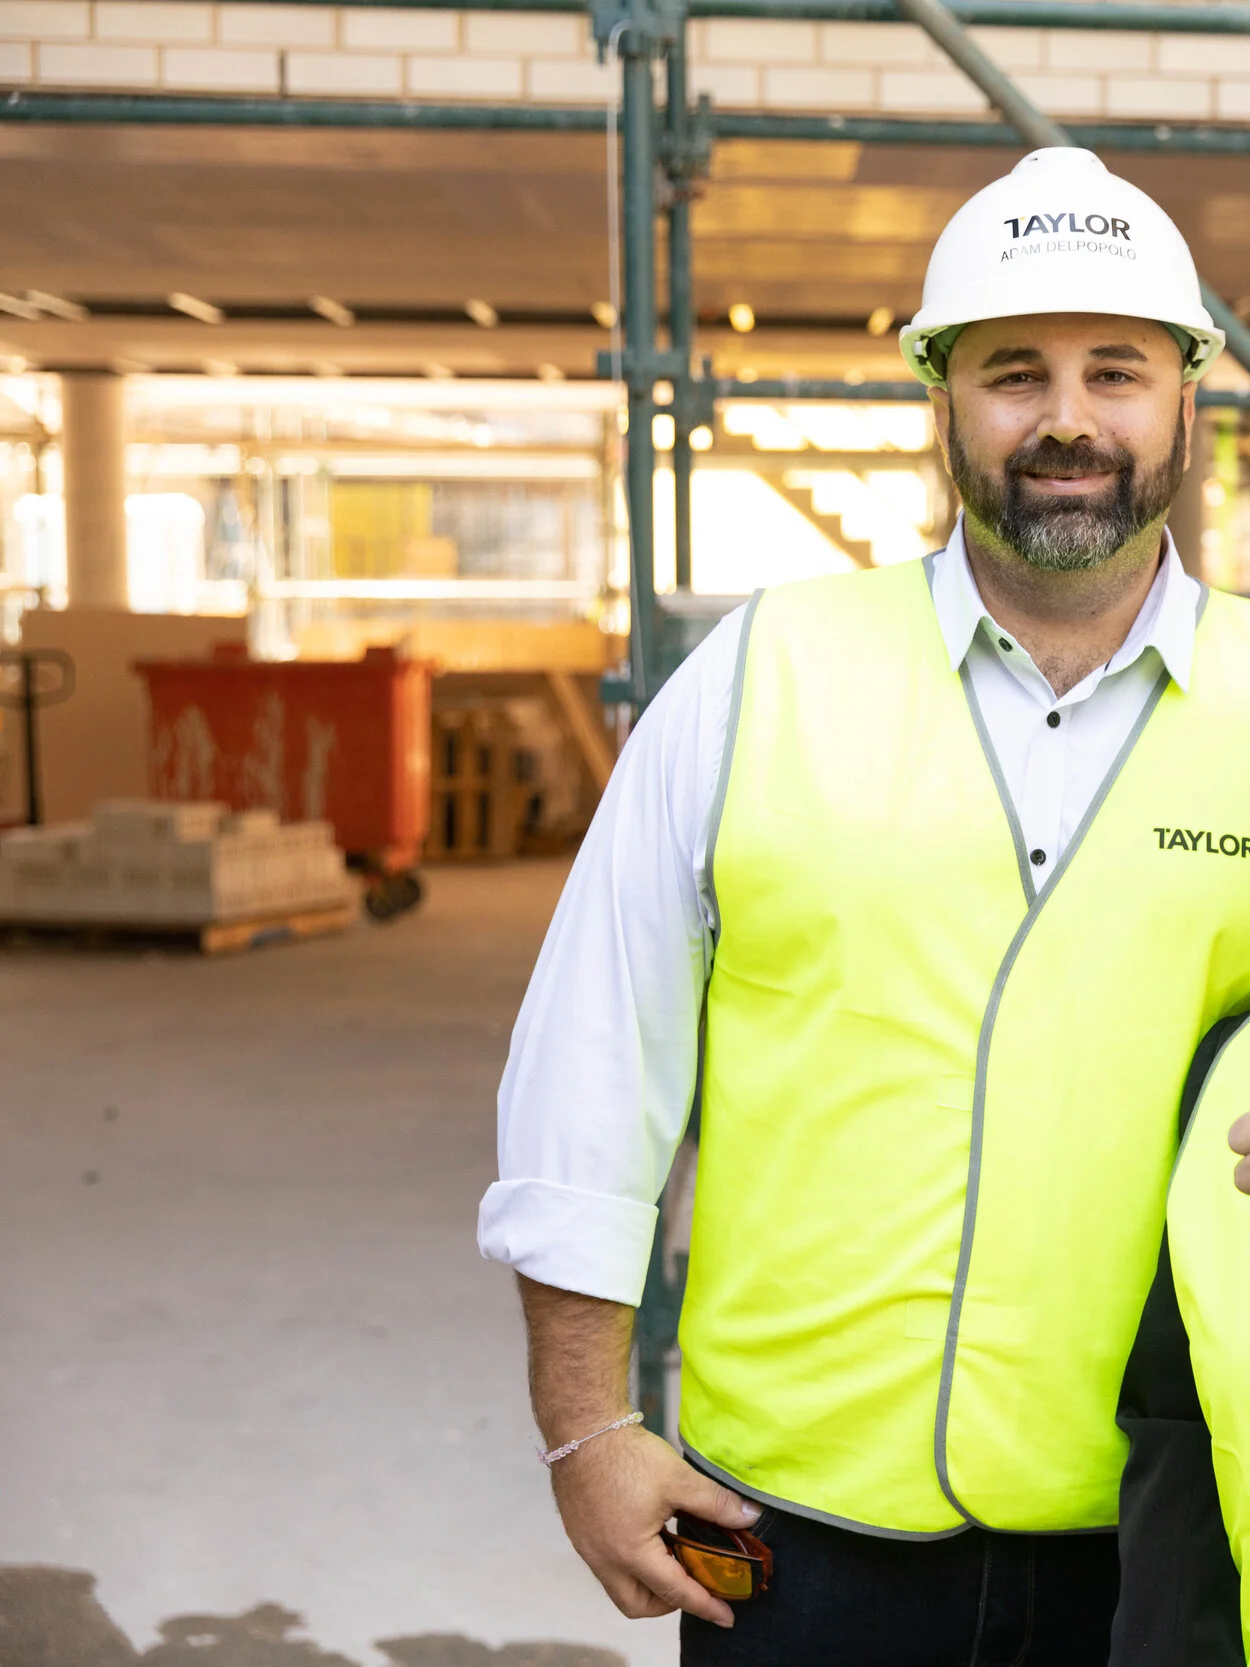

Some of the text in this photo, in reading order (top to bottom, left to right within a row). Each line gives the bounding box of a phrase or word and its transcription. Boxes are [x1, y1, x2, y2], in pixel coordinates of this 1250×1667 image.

[1003, 212, 1131, 241] TAYLOR
[1000, 240, 1137, 263] ADAM DELPOPOLO
